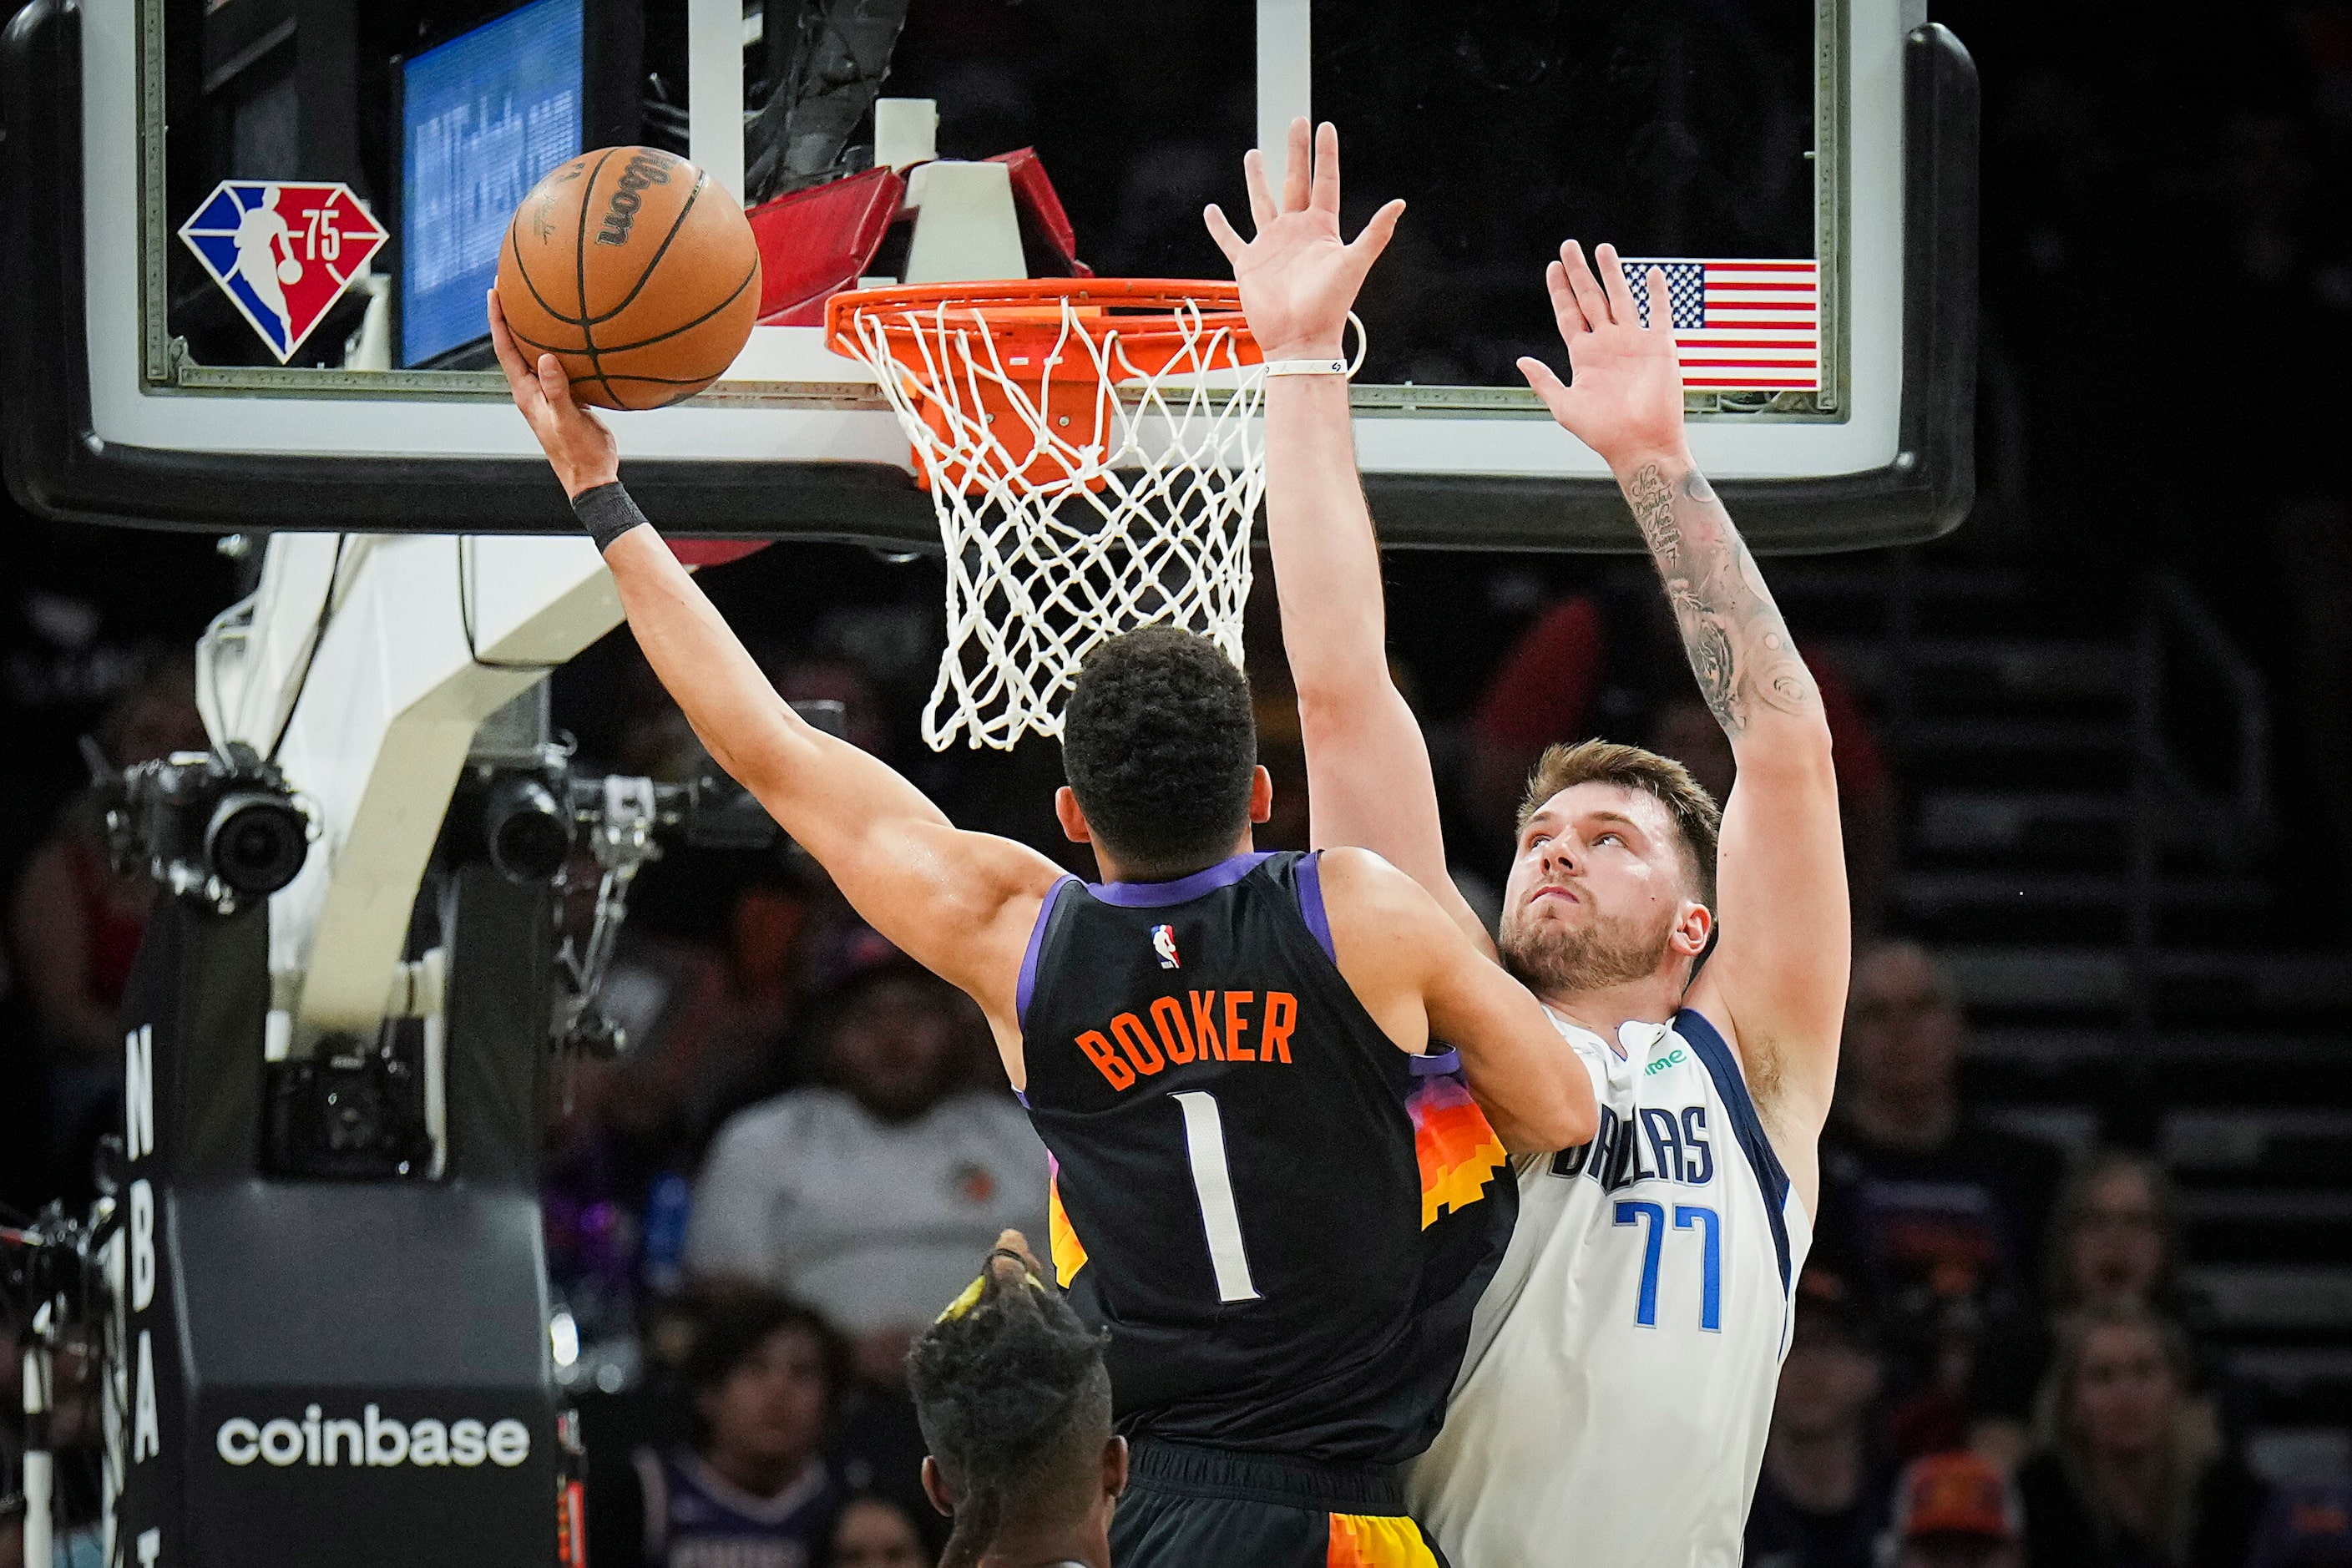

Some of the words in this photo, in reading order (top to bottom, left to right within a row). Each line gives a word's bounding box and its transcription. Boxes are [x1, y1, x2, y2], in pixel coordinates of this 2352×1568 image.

[301, 208, 341, 261] 75
[1075, 989, 1297, 1092] BOOKER
[1166, 1090, 1265, 1304] 1
[1612, 1197, 1722, 1334] 77
[215, 1403, 531, 1467] coinbase
